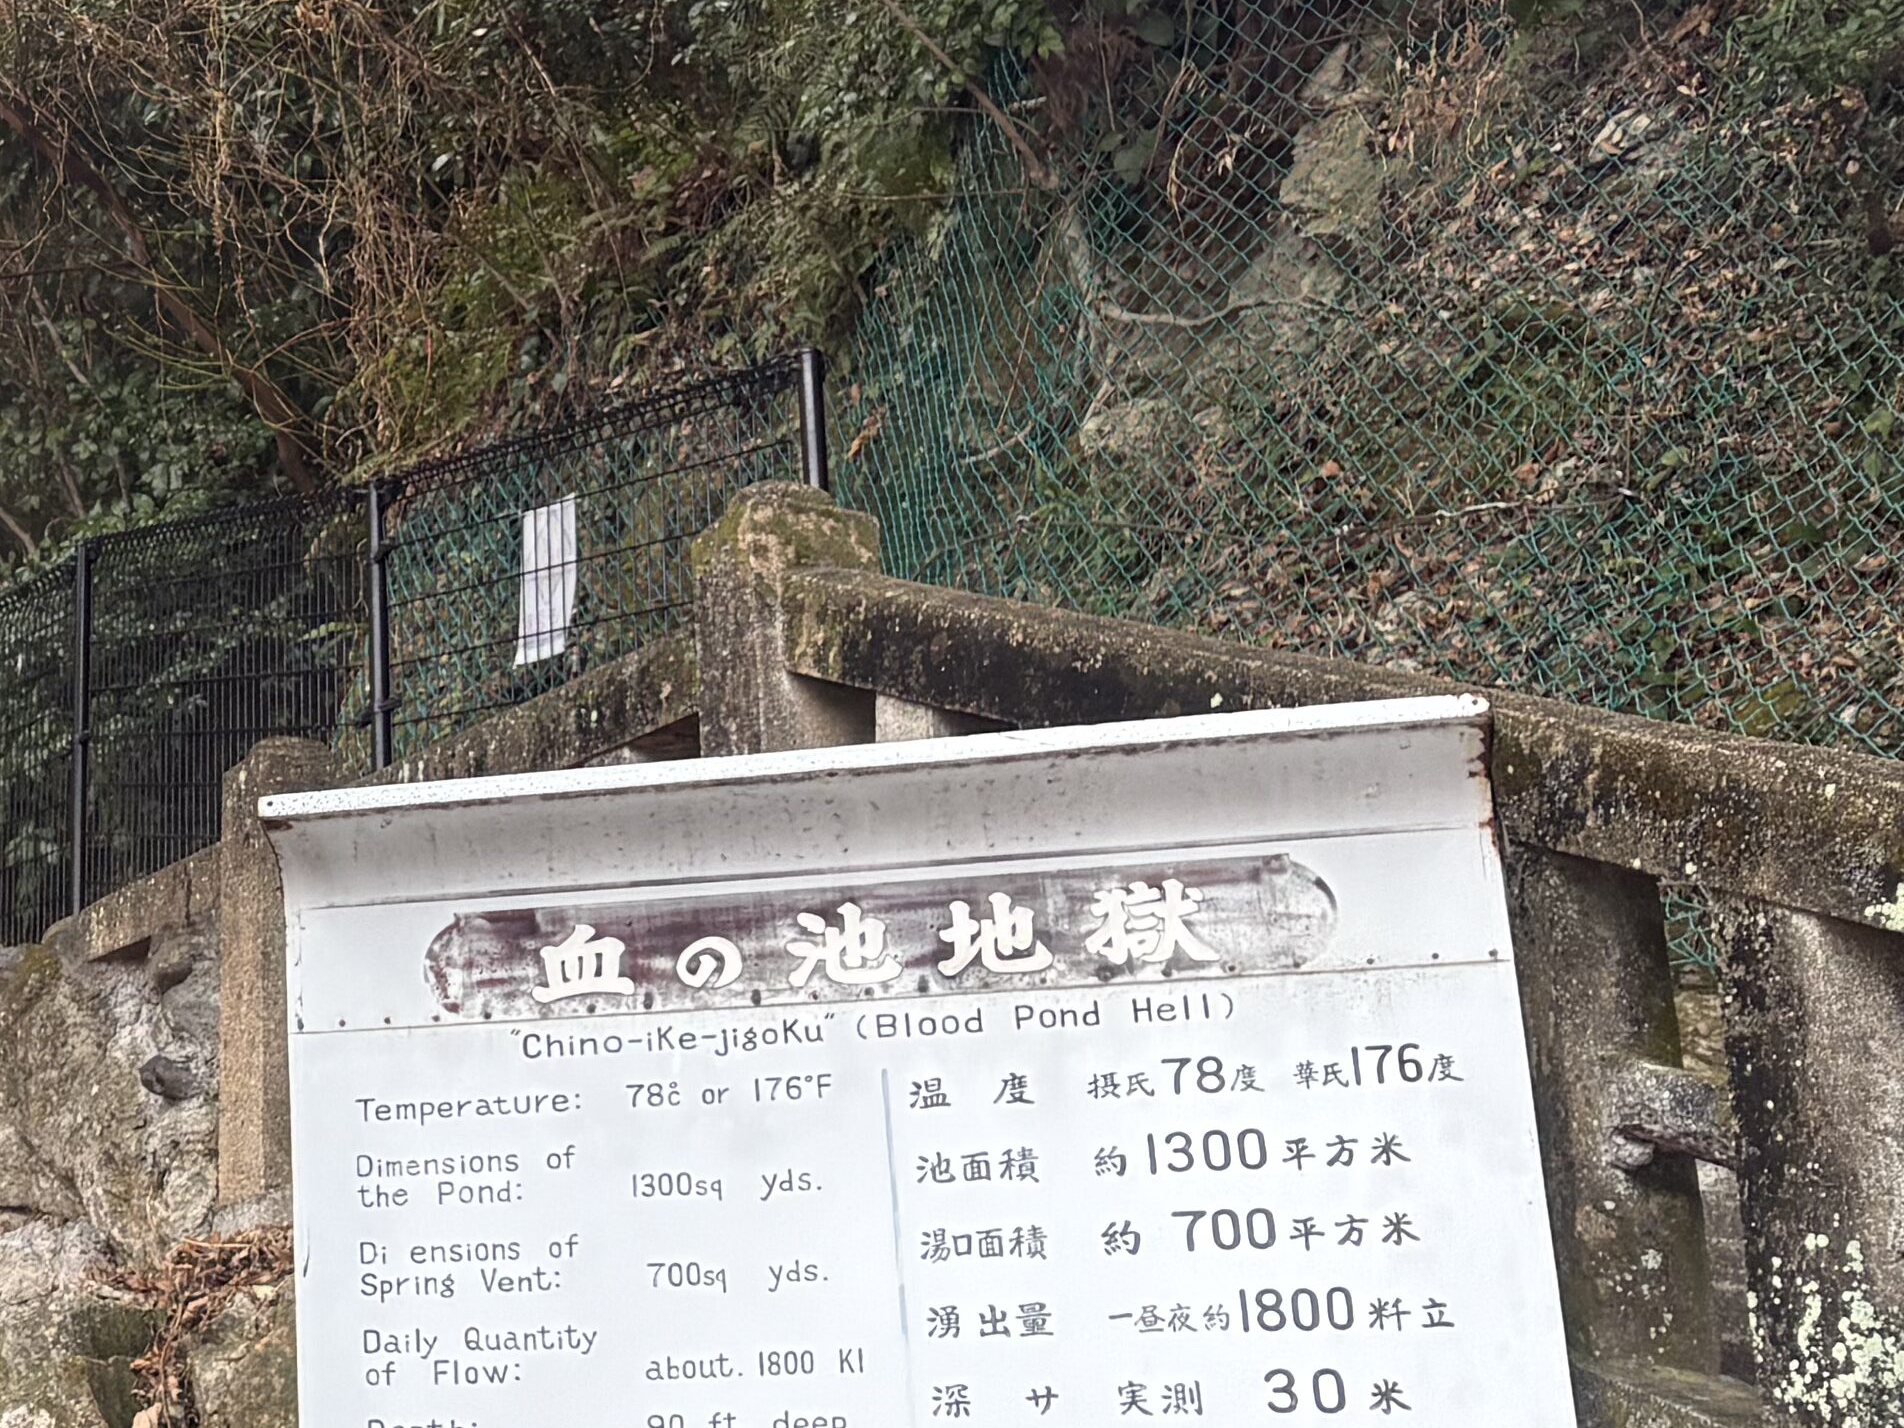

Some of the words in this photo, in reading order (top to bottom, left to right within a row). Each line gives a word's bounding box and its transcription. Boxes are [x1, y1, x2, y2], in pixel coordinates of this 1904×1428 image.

[530, 878, 1222, 1004] 血の池地獄
[856, 1007, 984, 1041] (Blood
[1014, 999, 1101, 1031] Pond
[1131, 992, 1234, 1024] Hell)
[354, 1092, 582, 1127] Temperature:
[701, 1087, 730, 1106] or
[754, 1072, 832, 1103] 176°F
[356, 1153, 520, 1178] Dimensions
[546, 1143, 576, 1170] of
[915, 1145, 1040, 1184] 池面積
[356, 1183, 409, 1209] the
[437, 1179, 523, 1206] Pond:
[759, 1168, 823, 1202] yds.
[548, 1232, 580, 1259] of
[919, 1224, 1048, 1264] 湯口面積
[360, 1272, 455, 1304] Spring
[480, 1265, 561, 1293] Vent:
[767, 1259, 829, 1293] yds.
[926, 1301, 1055, 1339] 湧出量
[362, 1327, 438, 1361] Daily
[463, 1324, 598, 1356] Quantity
[365, 1360, 397, 1387] of
[433, 1359, 521, 1386] Flow:
[645, 1352, 744, 1381] about.
[758, 1349, 815, 1377] 1800
